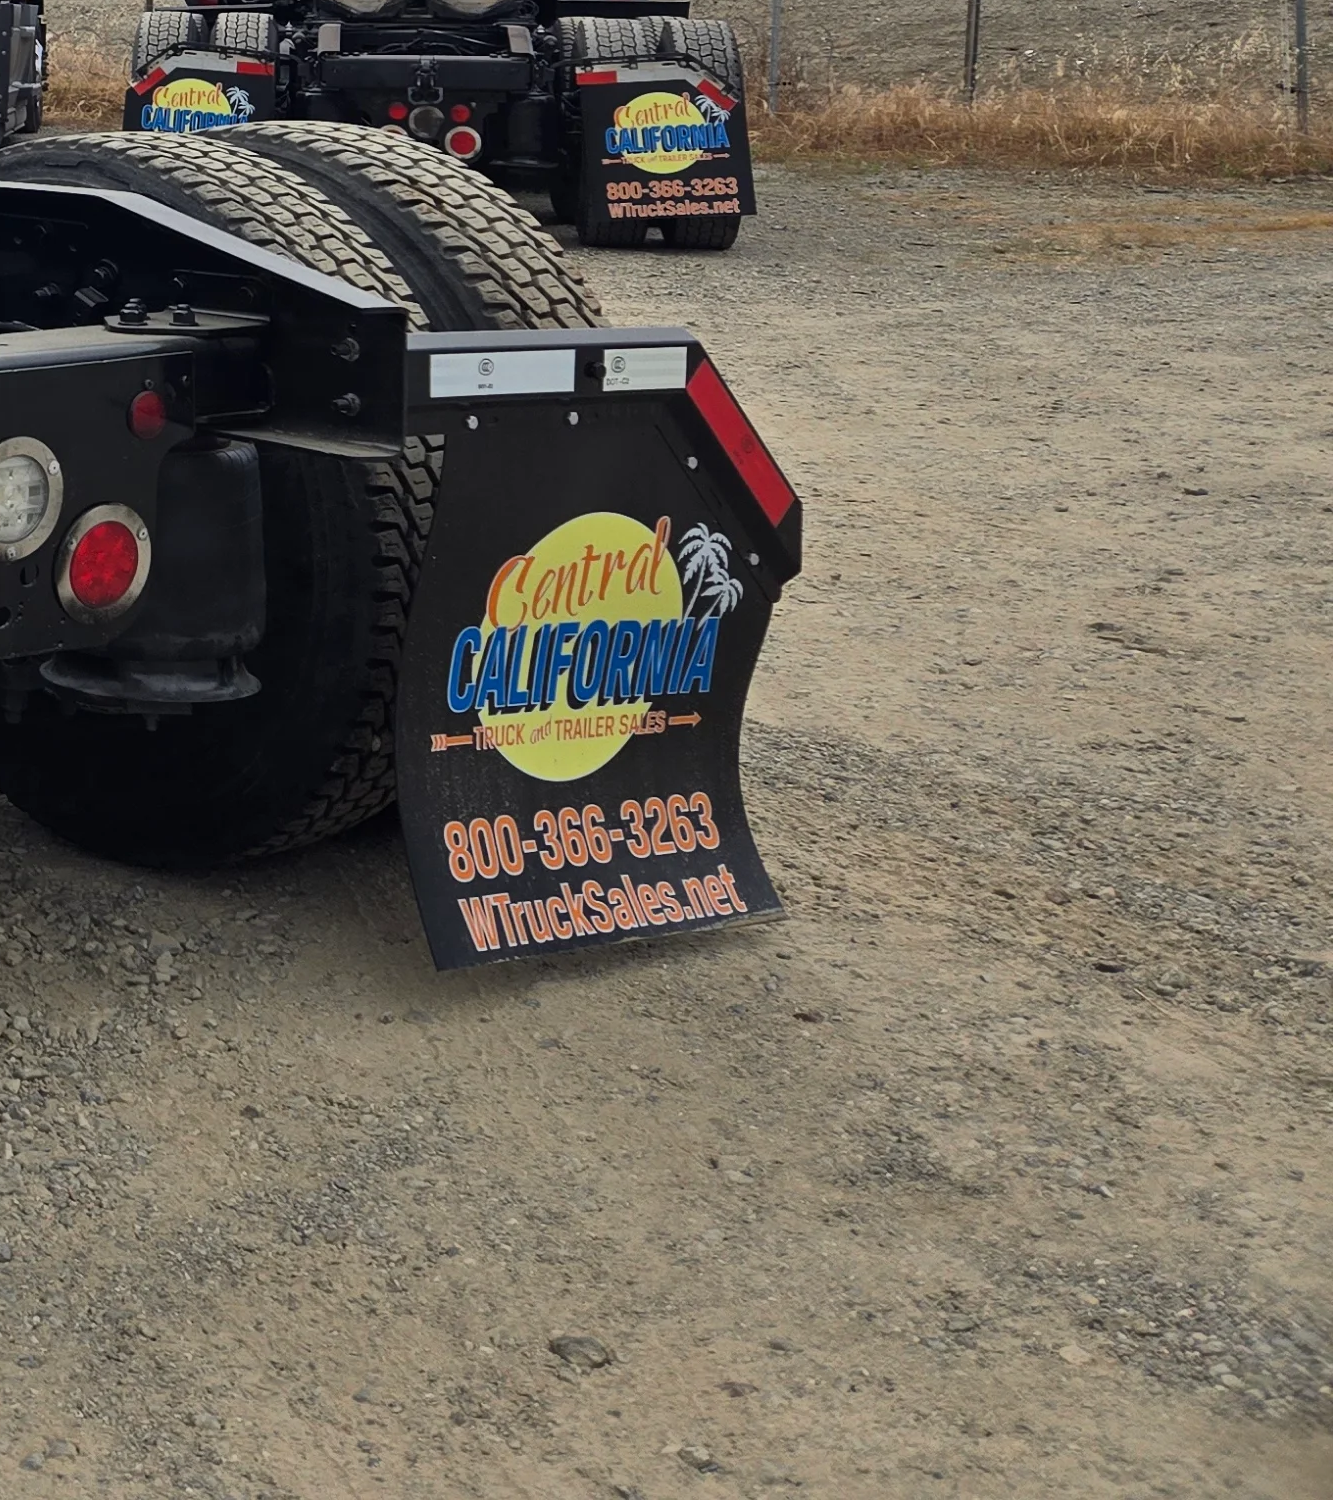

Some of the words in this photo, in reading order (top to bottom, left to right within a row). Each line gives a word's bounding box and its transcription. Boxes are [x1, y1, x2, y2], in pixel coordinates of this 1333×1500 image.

[153, 82, 223, 108] Central
[613, 91, 691, 129] Central
[141, 104, 248, 133] CALIFORN
[605, 122, 731, 154] CALIFORNIA
[606, 176, 739, 200] 800-366-3263
[607, 197, 741, 219] WTruckSales.net
[486, 515, 671, 632] Central
[447, 616, 721, 714] CALIFORNIA
[473, 723, 525, 751] TRUCK
[530, 714, 553, 745] and
[554, 715, 615, 740] TRAILER
[618, 710, 667, 735] SALES
[444, 791, 720, 883] 800-366-3263
[458, 863, 748, 952] WTruckSales.net
